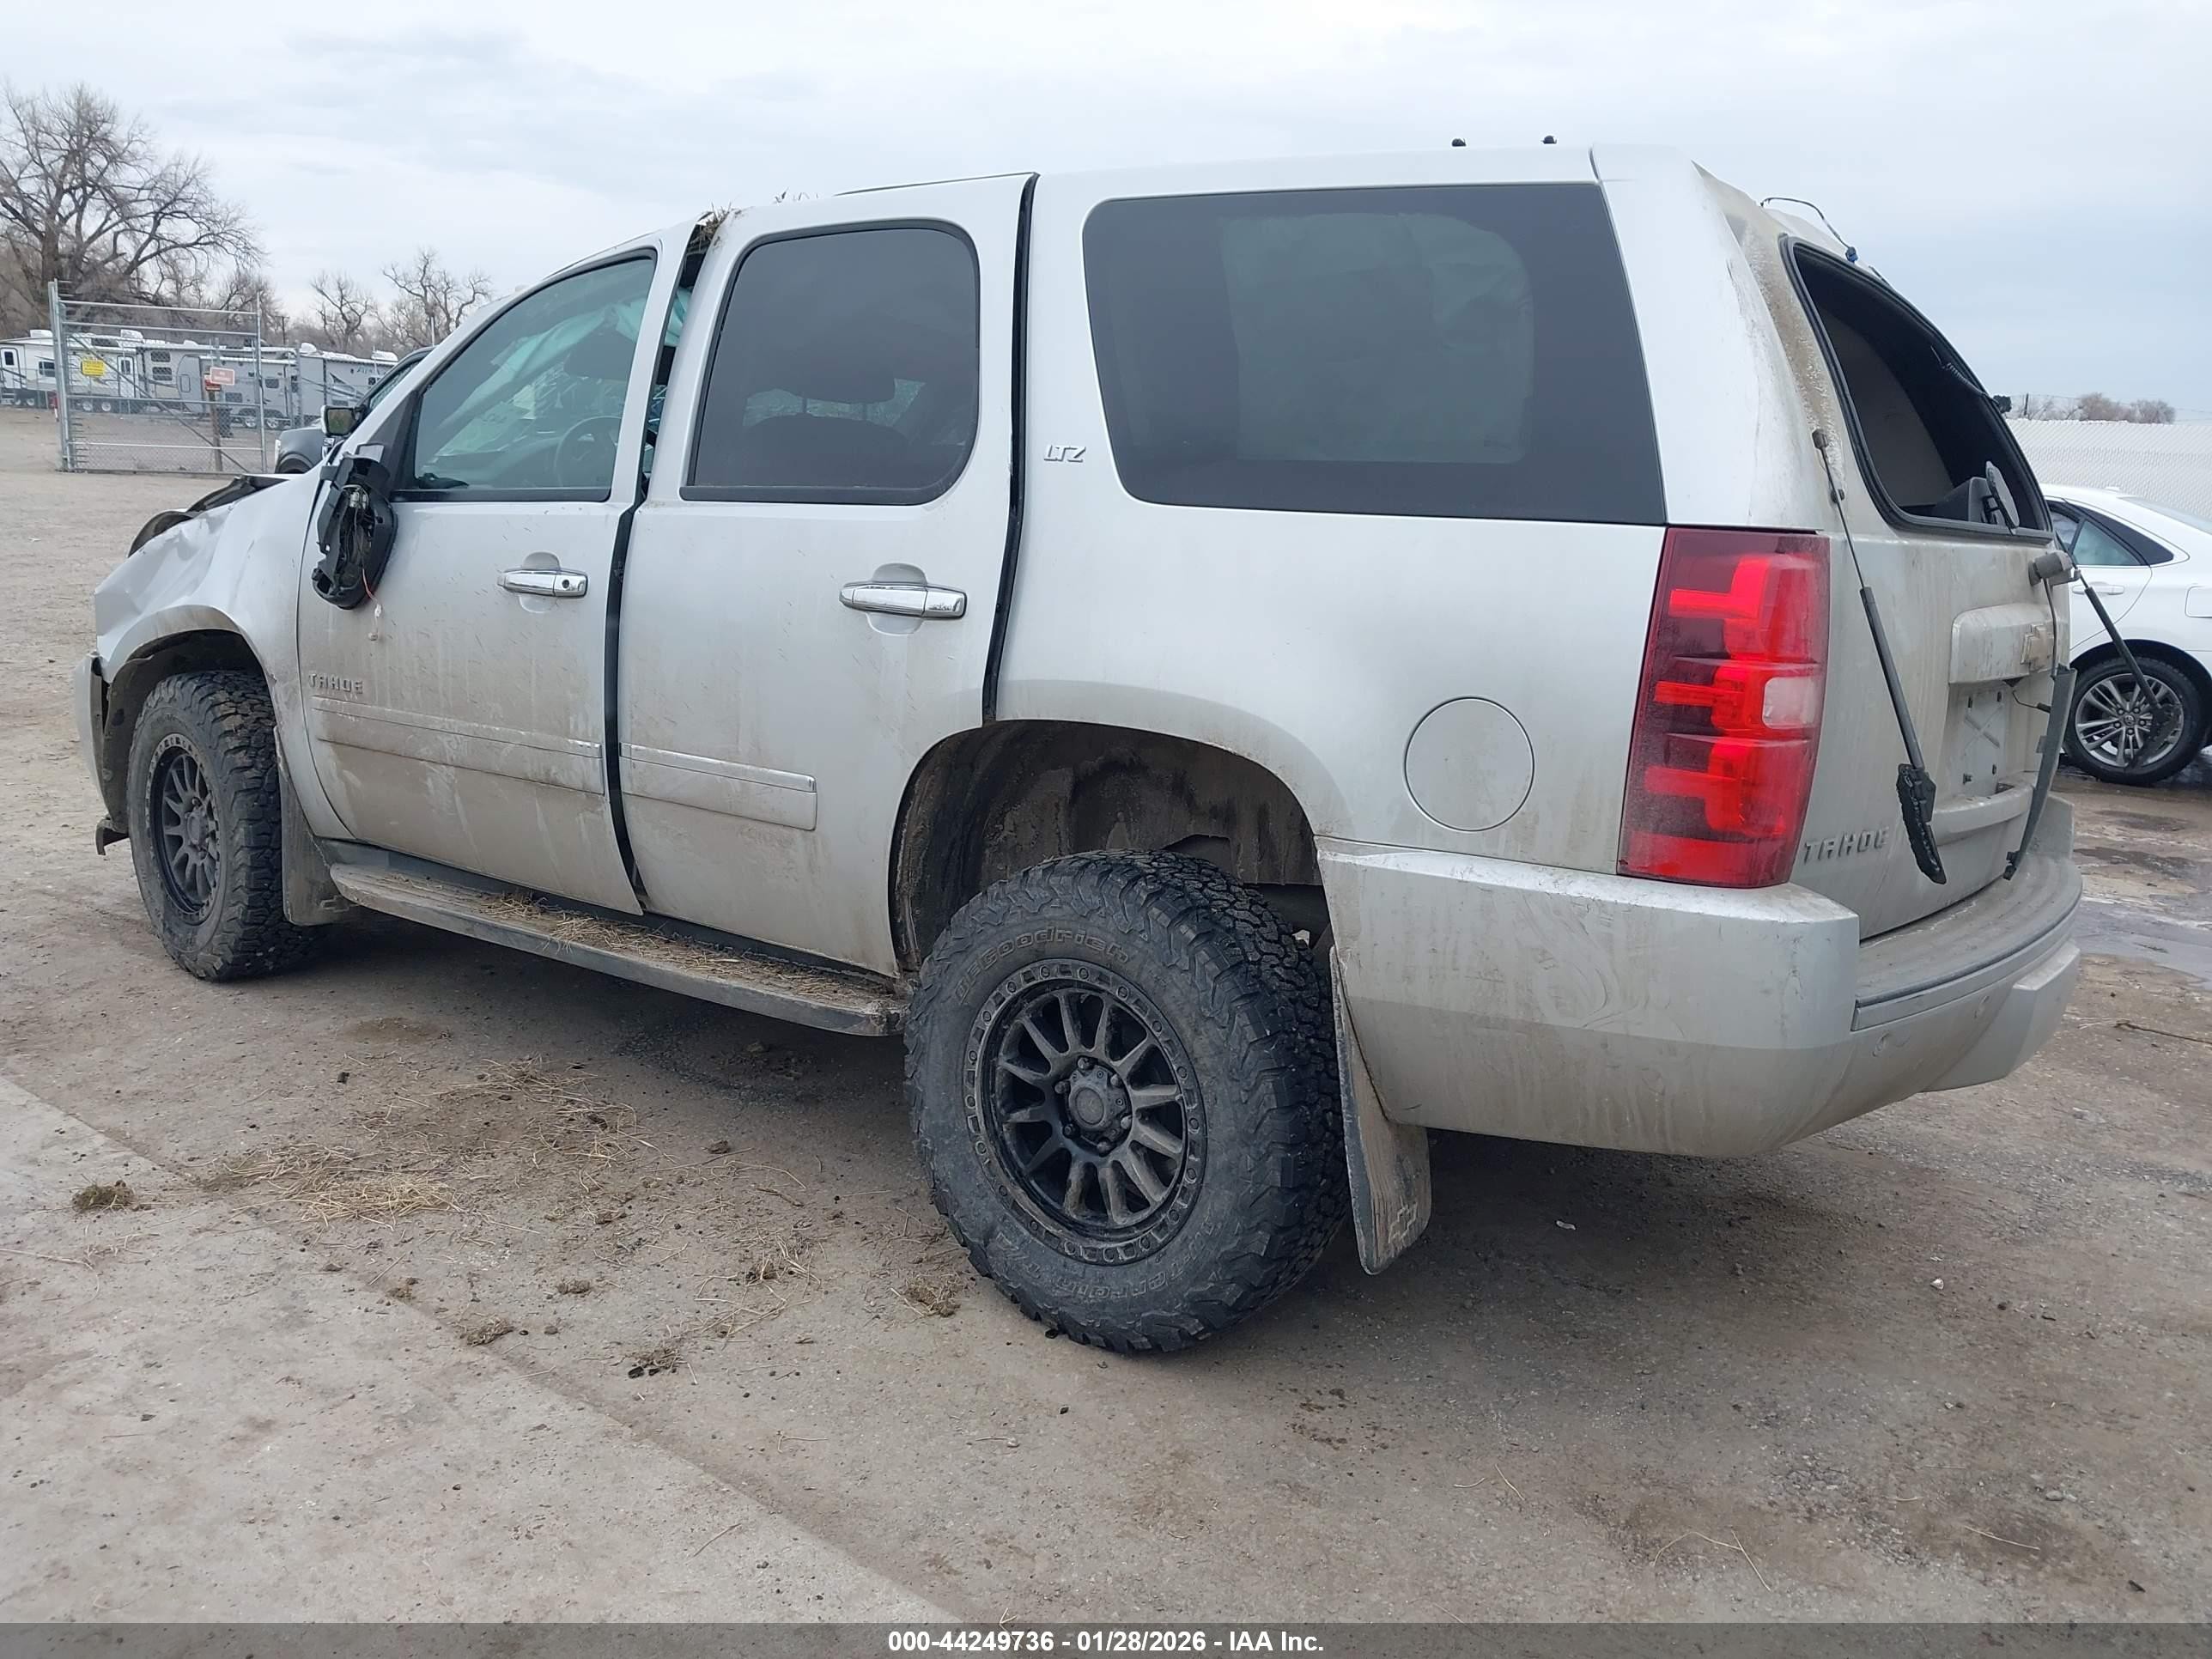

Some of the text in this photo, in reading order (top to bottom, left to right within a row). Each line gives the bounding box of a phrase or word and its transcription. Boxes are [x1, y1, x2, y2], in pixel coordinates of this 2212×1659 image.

[1043, 445, 1086, 464] LTZ
[309, 672, 363, 695] TAHOE
[1804, 829, 1888, 865] TAHOE
